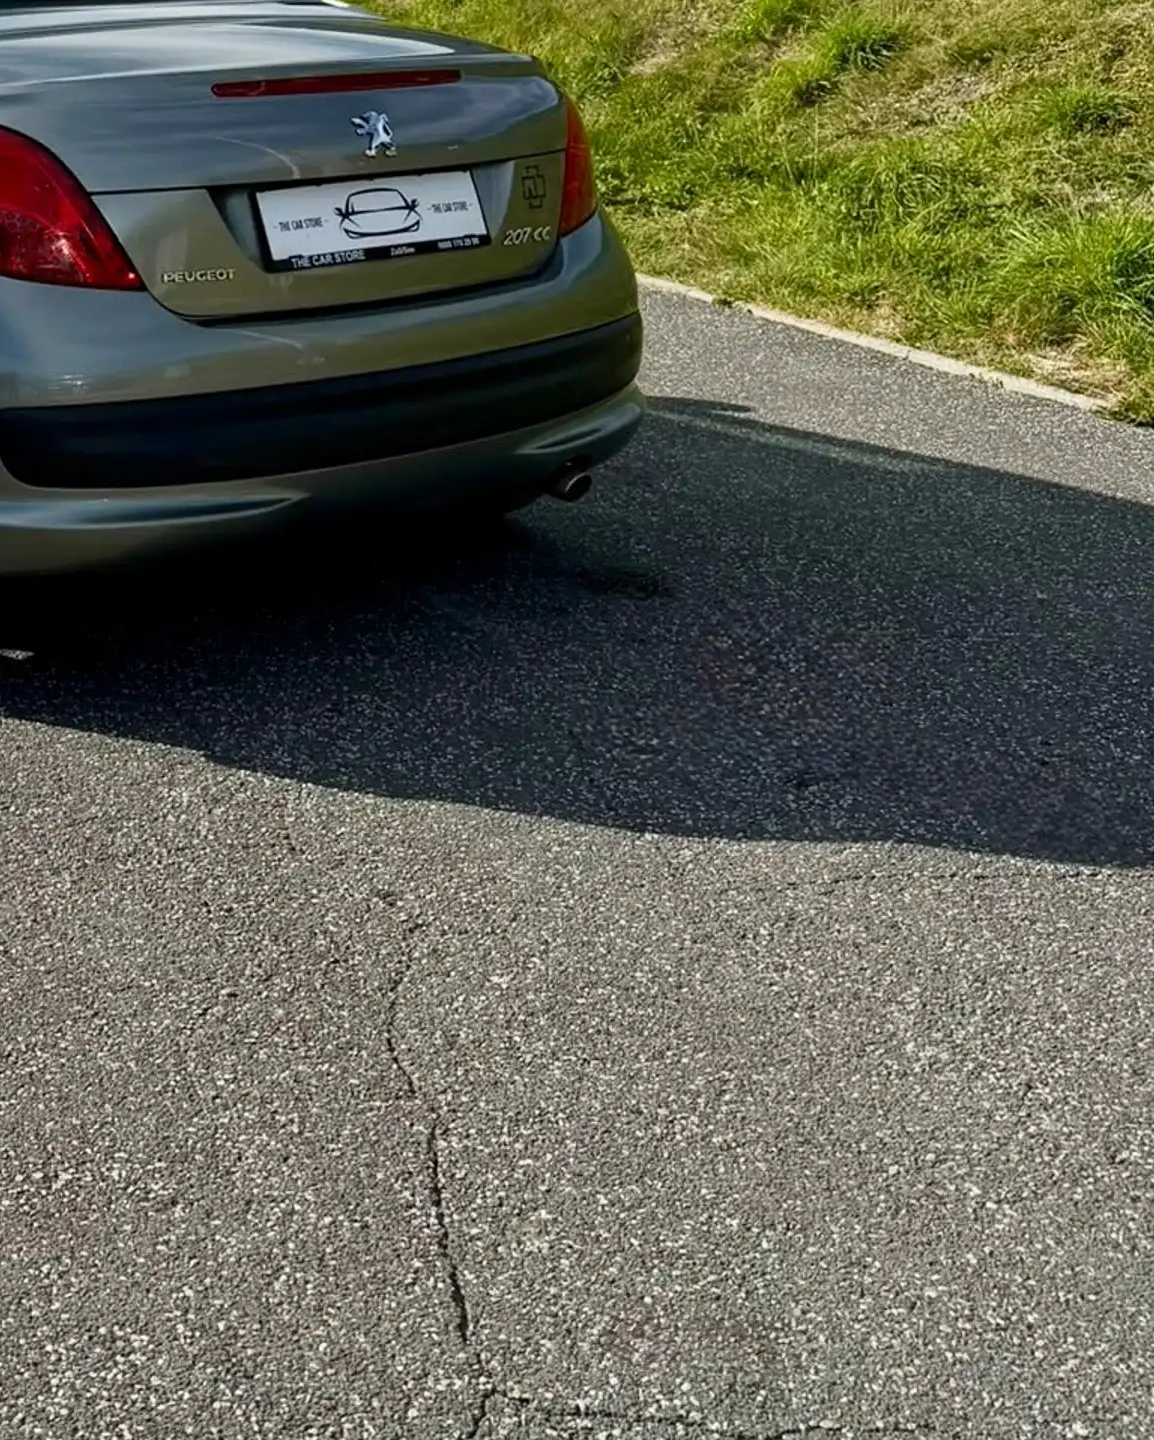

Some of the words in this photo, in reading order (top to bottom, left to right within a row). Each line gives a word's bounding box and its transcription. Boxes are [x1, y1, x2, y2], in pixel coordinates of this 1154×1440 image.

[503, 226, 532, 245] 207
[291, 256, 311, 269] THE
[312, 254, 333, 266] CAR
[334, 249, 366, 263] STORE
[163, 268, 237, 283] PEUGEOT
